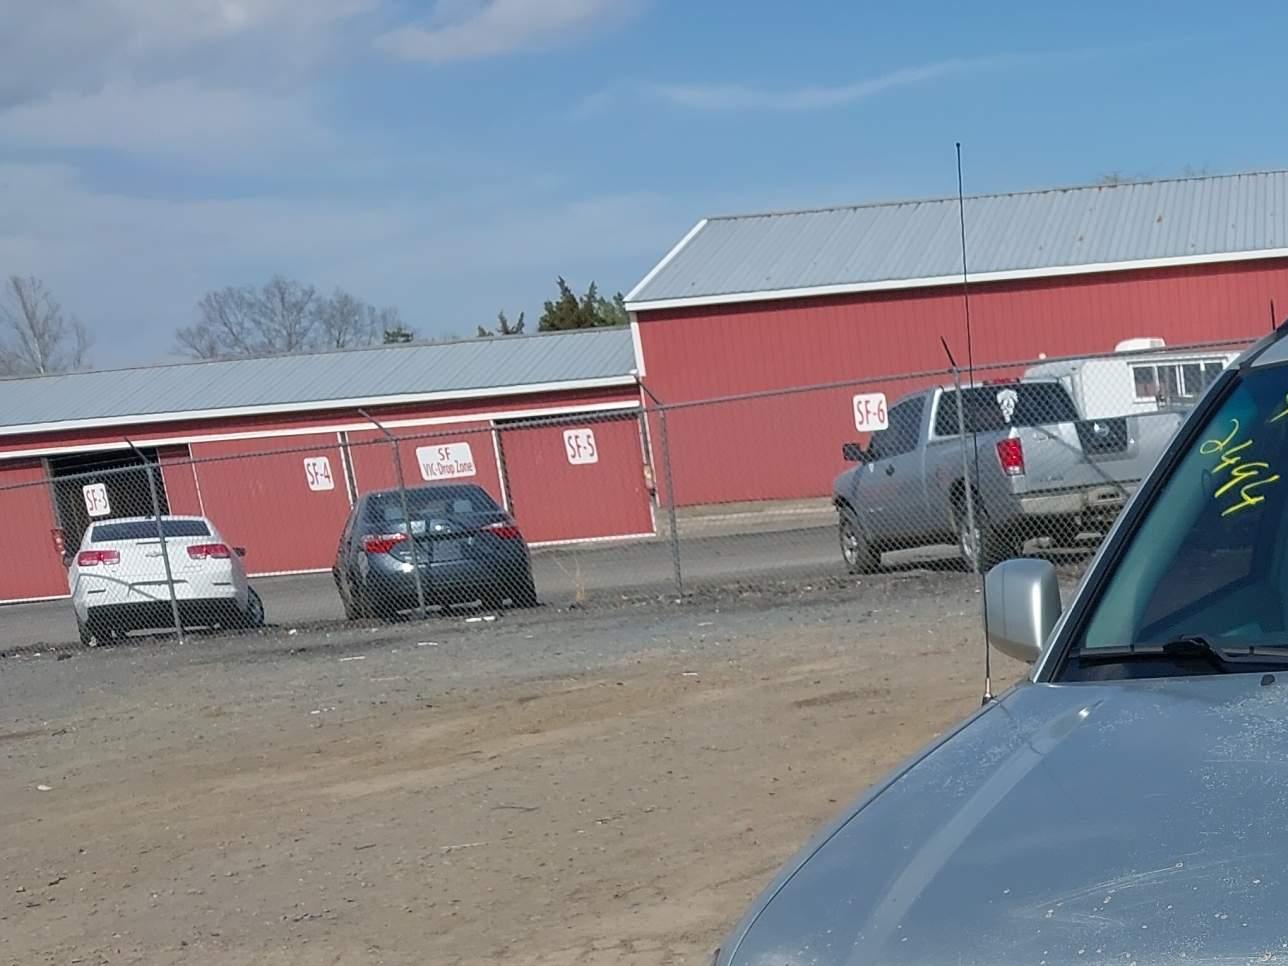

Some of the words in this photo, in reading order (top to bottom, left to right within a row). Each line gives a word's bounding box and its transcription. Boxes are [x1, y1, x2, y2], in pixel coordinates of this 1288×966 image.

[856, 400, 886, 425] SF-6
[437, 447, 451, 461] SF
[567, 434, 595, 459] SF-5
[306, 462, 331, 486] SF-4
[454, 459, 473, 473] Zone
[1199, 418, 1281, 518] 2494
[85, 488, 108, 512] SF-3
